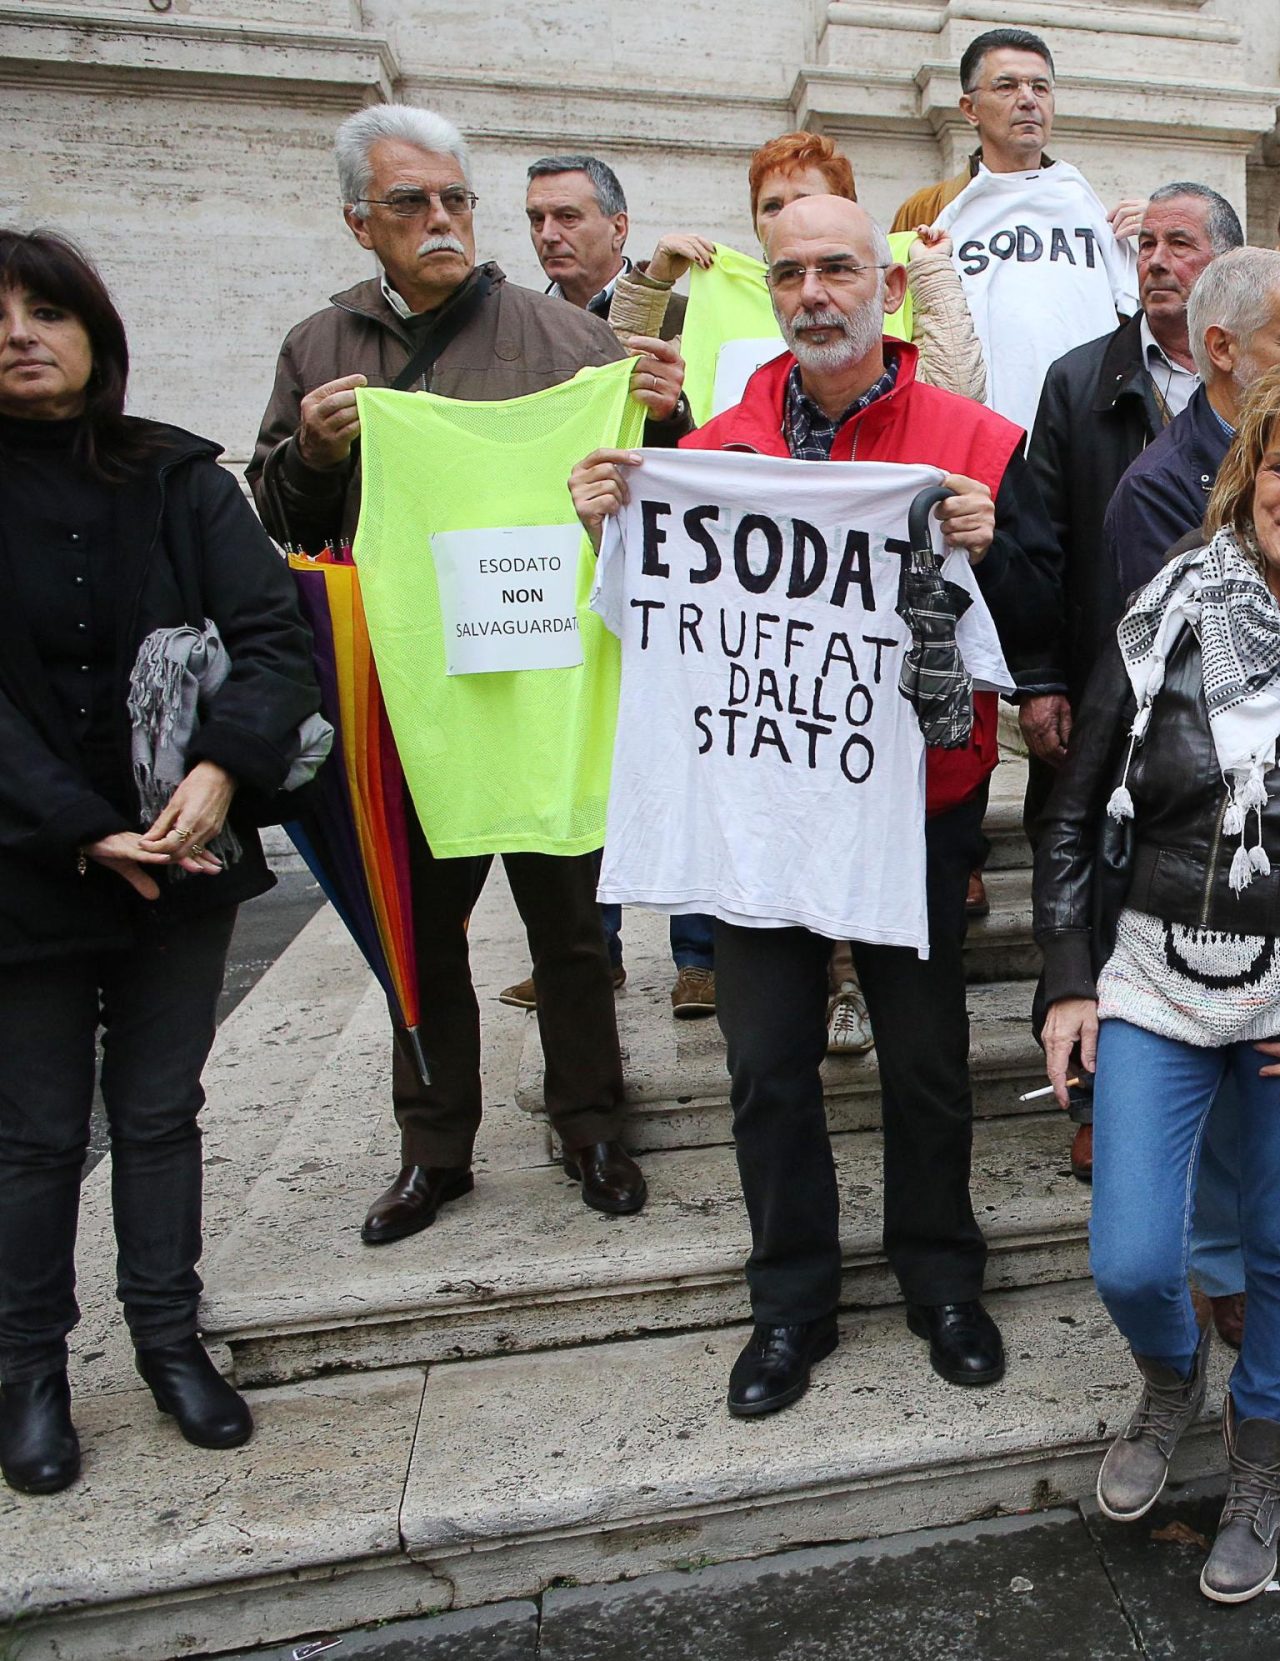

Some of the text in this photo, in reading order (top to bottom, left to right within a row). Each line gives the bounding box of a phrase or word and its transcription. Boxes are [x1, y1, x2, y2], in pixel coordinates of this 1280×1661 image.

[479, 556, 561, 574] ESODATO
[502, 588, 544, 604] NON
[728, 662, 874, 726] DALLO
[694, 706, 874, 783] STATO
